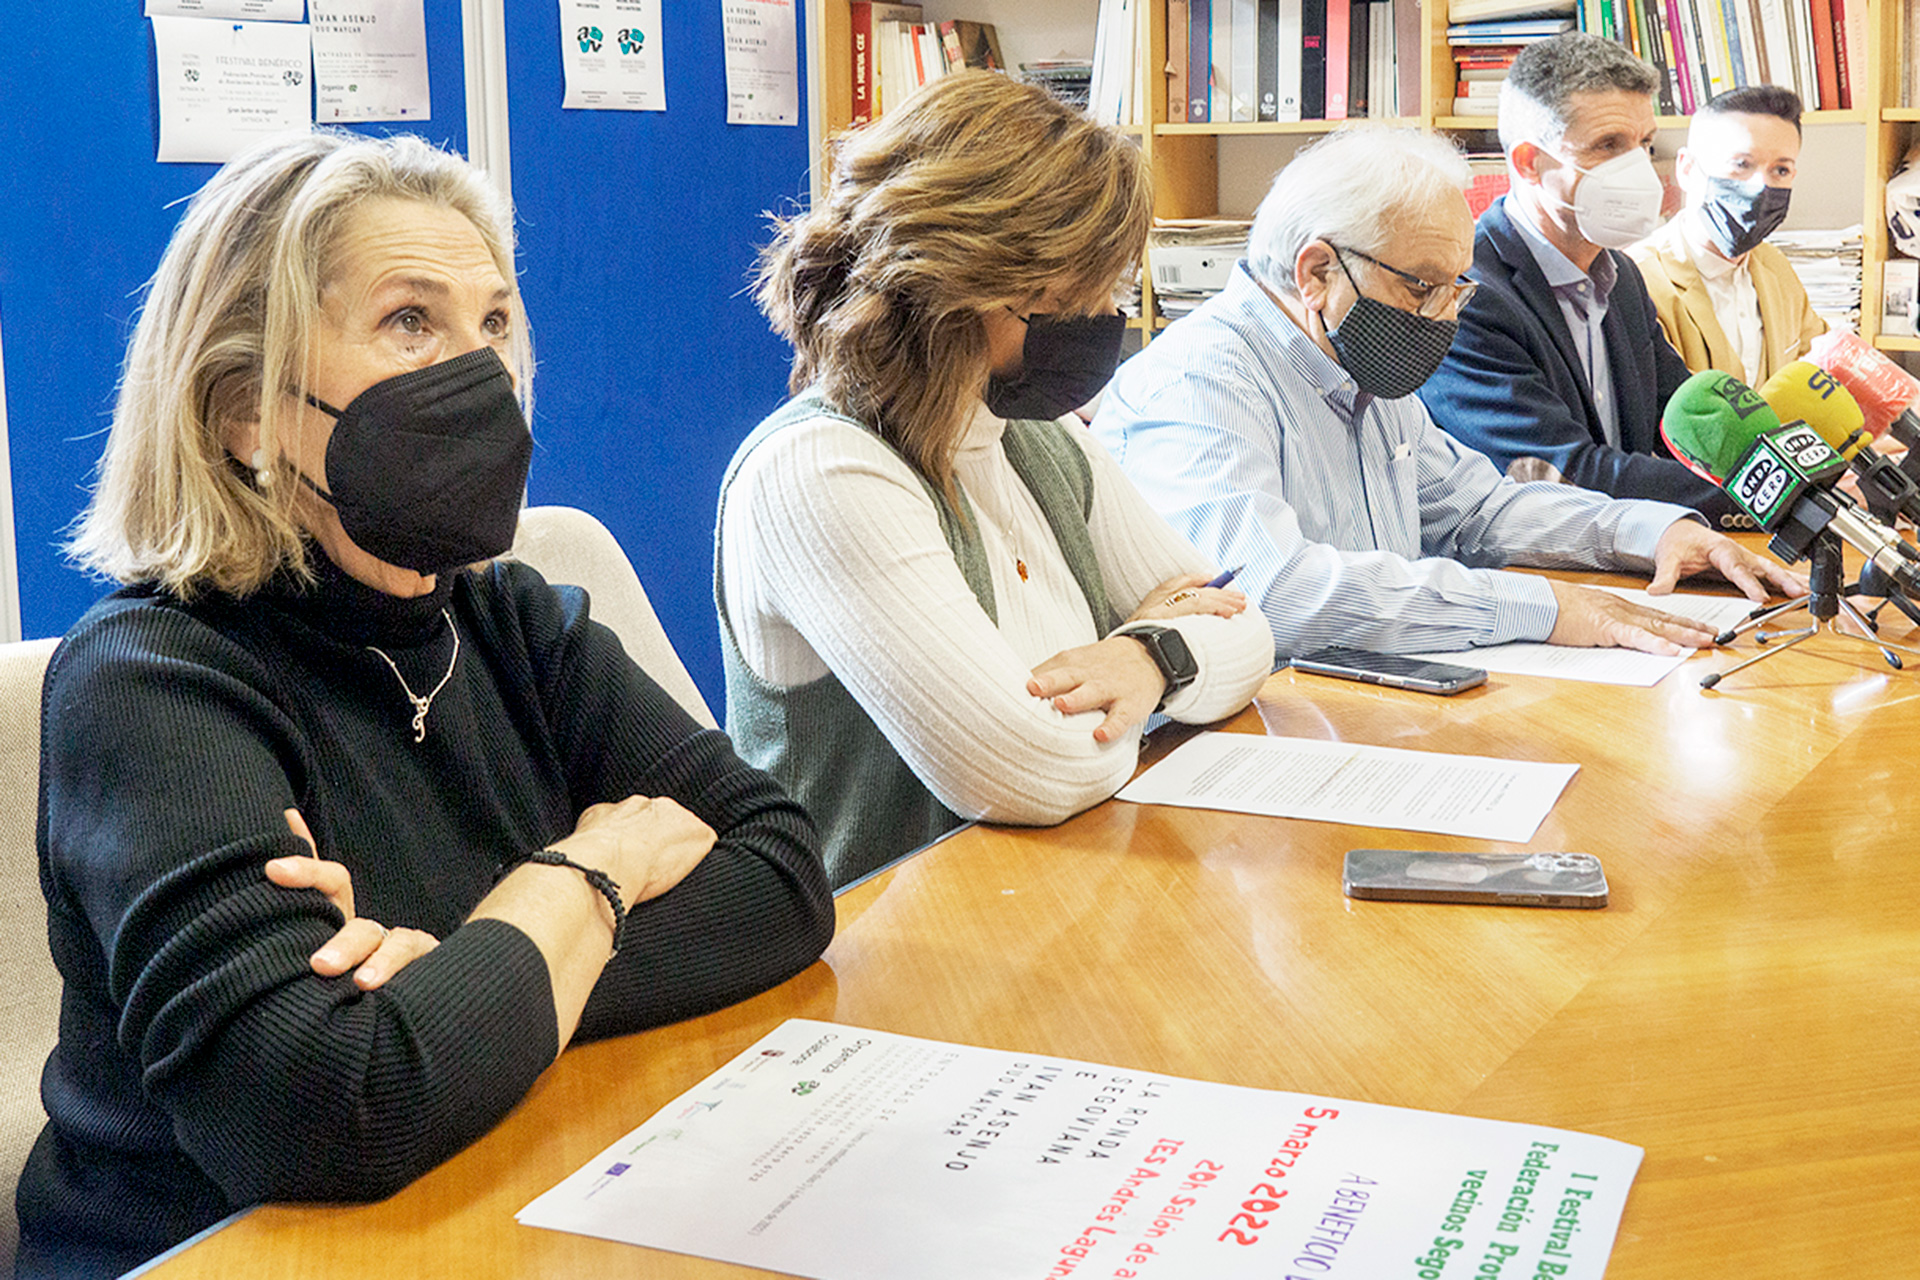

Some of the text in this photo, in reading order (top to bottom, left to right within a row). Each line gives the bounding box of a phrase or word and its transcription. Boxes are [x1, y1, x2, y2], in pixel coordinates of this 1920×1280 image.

[314, 14, 377, 24] IVAN ASENJO
[333, 26, 361, 34] MAYCAR
[857, 52, 865, 84] NUEVA
[857, 85, 865, 100] LA
[1785, 435, 1816, 453] ONDA
[1744, 461, 1771, 496] ONDA
[1757, 474, 1783, 507] CERO
[820, 1039, 872, 1073] Organiza
[1075, 1071, 1098, 1079] E
[892, 1052, 960, 1104] ENTRADAS
[943, 1063, 1030, 1136] DUO MAYCAR
[944, 1066, 1062, 1171] IVAN ASENJO
[1036, 1077, 1133, 1164] SEGOVIANA
[1086, 1081, 1171, 1158] LA RONDA
[1180, 1159, 1224, 1190] 20h
[1217, 1106, 1340, 1246] 5 marzo 2022
[1496, 1141, 1560, 1233] Federación
[1570, 1172, 1599, 1181] I
[1046, 1137, 1185, 1279] IES Andrés Lagun
[1144, 1194, 1197, 1238] Salón
[1440, 1169, 1488, 1233] vecinos
[1292, 1172, 1380, 1271] A BENEFICIO
[1542, 1187, 1593, 1258] Festival
[1124, 1242, 1159, 1264] de
